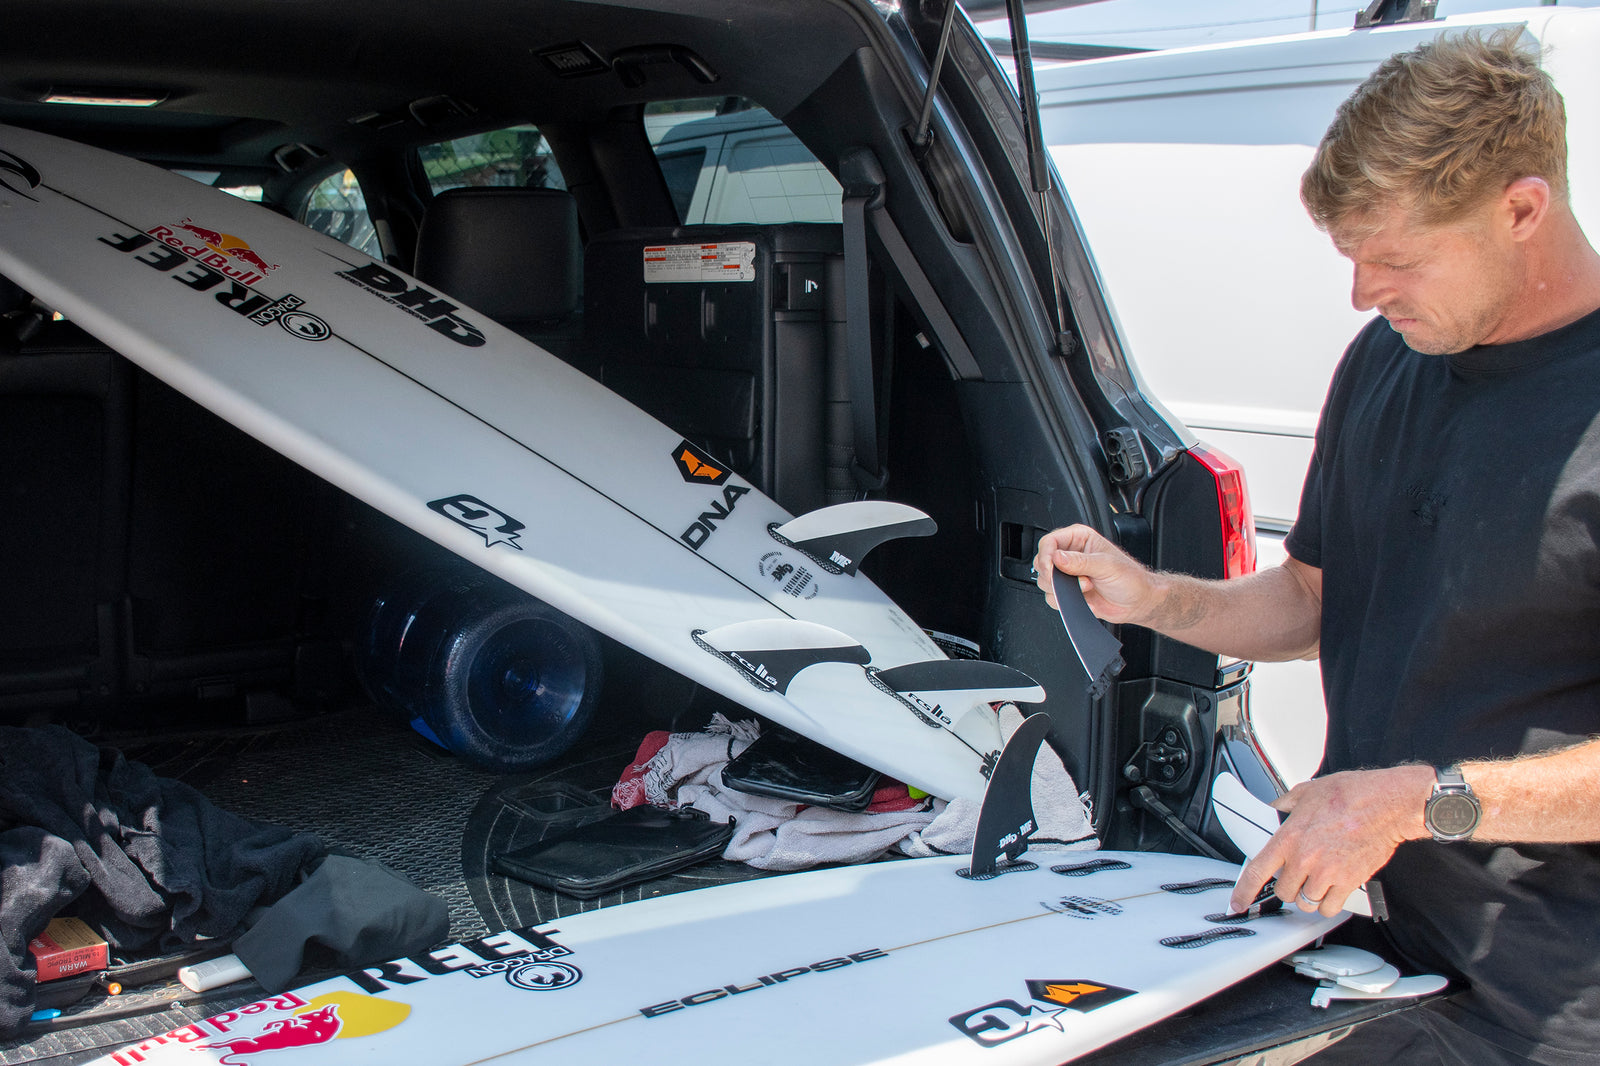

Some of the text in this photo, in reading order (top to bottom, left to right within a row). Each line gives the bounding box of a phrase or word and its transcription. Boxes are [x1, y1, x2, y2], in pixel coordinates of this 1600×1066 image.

[147, 225, 263, 286] Red Bull
[97, 233, 273, 317] REEF
[251, 295, 303, 325] DRAGON
[680, 485, 751, 551] DNA
[829, 550, 853, 568] MF
[730, 652, 756, 672] FCS
[908, 692, 931, 711] FCS
[1020, 819, 1032, 836] MF
[59, 960, 88, 973] WARM
[74, 952, 91, 961] MILD
[346, 921, 564, 995] REEF
[469, 946, 572, 977] DRAGON
[639, 948, 889, 1018] ECLIPSE
[109, 992, 309, 1066] Red Bull
